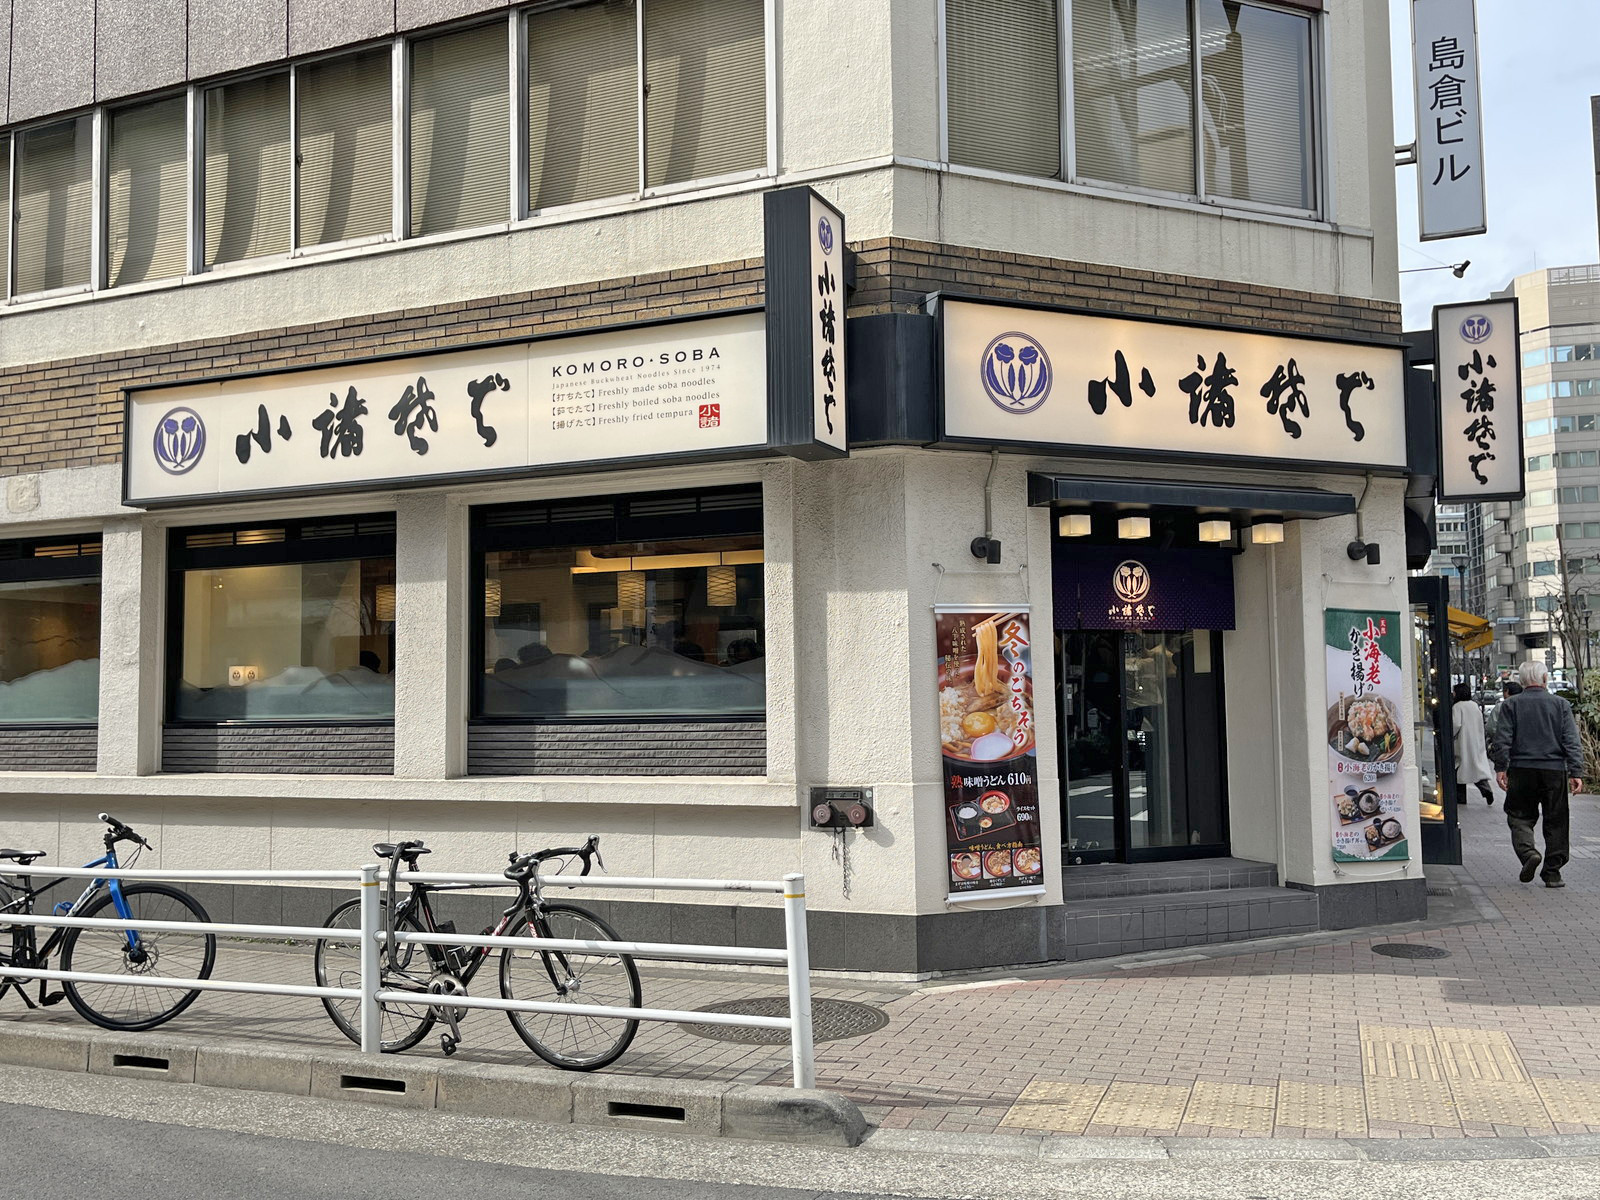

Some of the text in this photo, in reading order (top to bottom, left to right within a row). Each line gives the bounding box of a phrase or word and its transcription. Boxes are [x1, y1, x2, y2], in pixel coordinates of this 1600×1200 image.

[1428, 36, 1471, 186] 島倉ビル
[552, 364, 721, 390] Japanese Buckwheat Noodles Since 1974
[598, 386, 629, 398] Freshly
[632, 383, 655, 393] made
[658, 381, 678, 391] soba
[681, 377, 716, 388] noodles
[598, 401, 629, 412] Freshly
[632, 397, 659, 407] boiled
[662, 395, 683, 405] soba
[685, 391, 720, 402] noodles
[598, 415, 629, 426] Freshly
[632, 412, 653, 422] fried
[657, 409, 693, 420] tempura
[1350, 628, 1365, 698] かき揚げ
[1362, 618, 1382, 692] 小海老の
[999, 621, 1030, 744] 冬のごちそう
[1007, 772, 1032, 786] 610円
